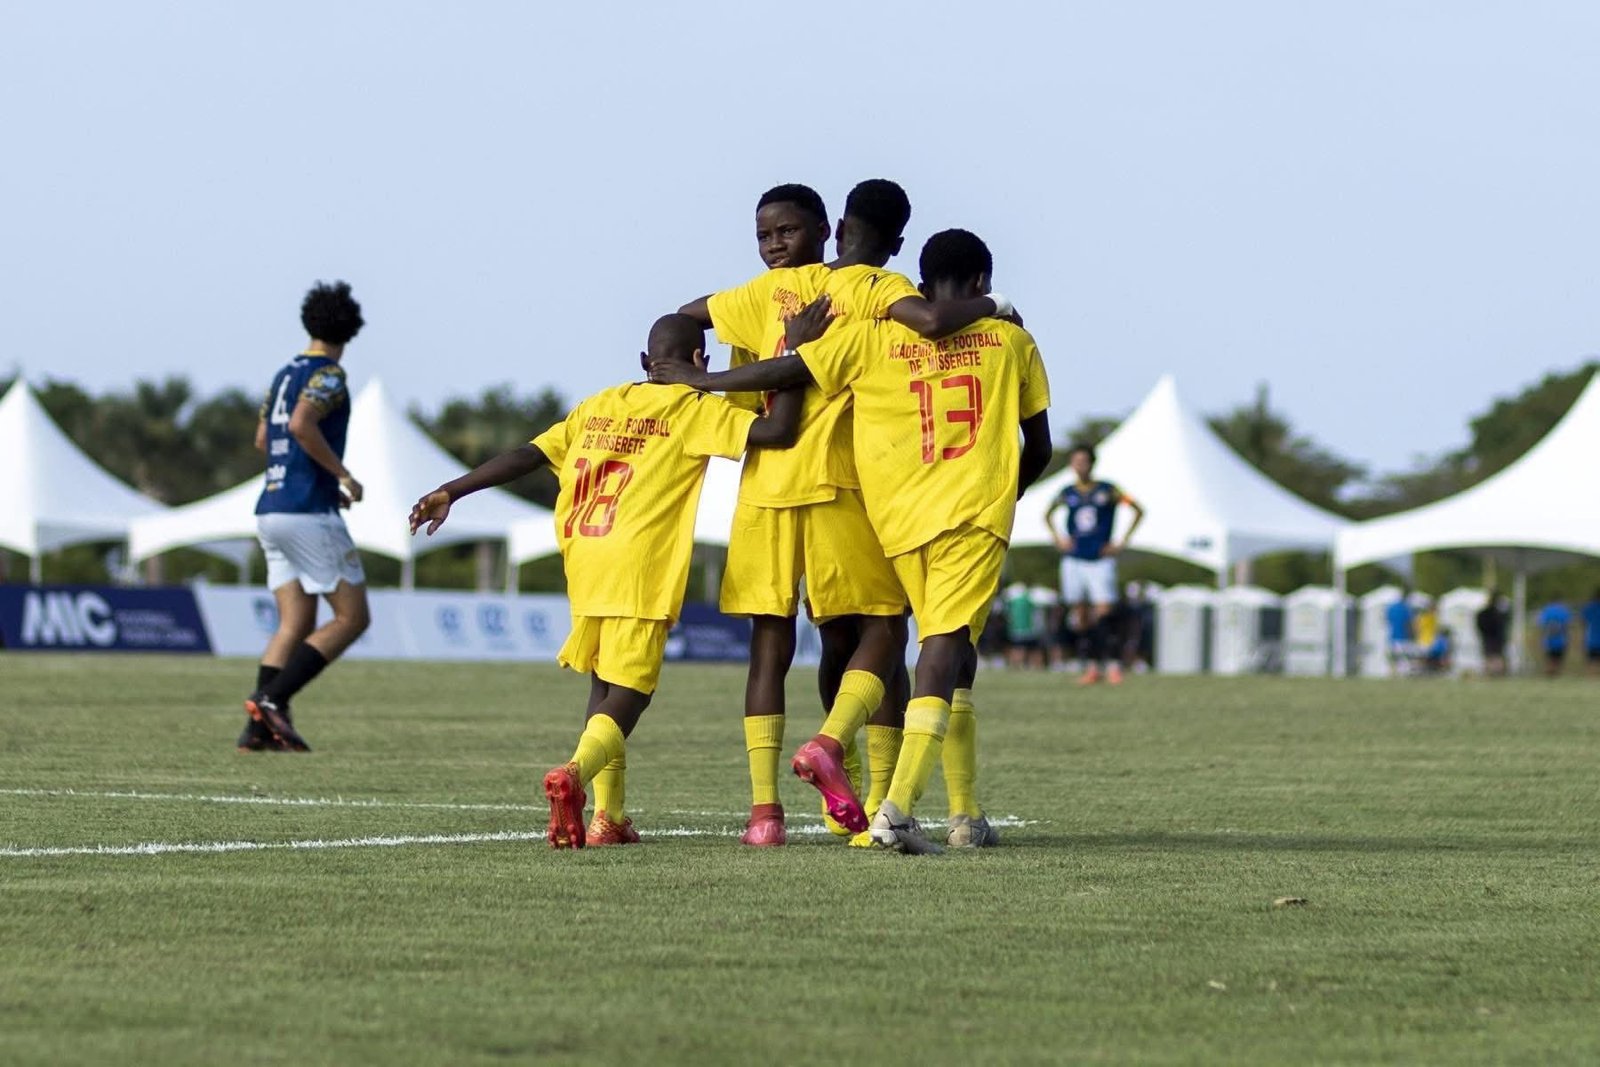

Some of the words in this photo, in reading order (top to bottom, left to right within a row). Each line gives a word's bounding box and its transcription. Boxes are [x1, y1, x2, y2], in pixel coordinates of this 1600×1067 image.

[953, 333, 1002, 351] FOOTBALL
[928, 351, 981, 371] MISSERETE
[271, 374, 291, 432] 4
[909, 375, 983, 464] 13
[597, 434, 646, 455] MISSERETE
[625, 417, 671, 437] FOOTBALL
[564, 457, 634, 538] 18
[22, 591, 117, 645] MIC
